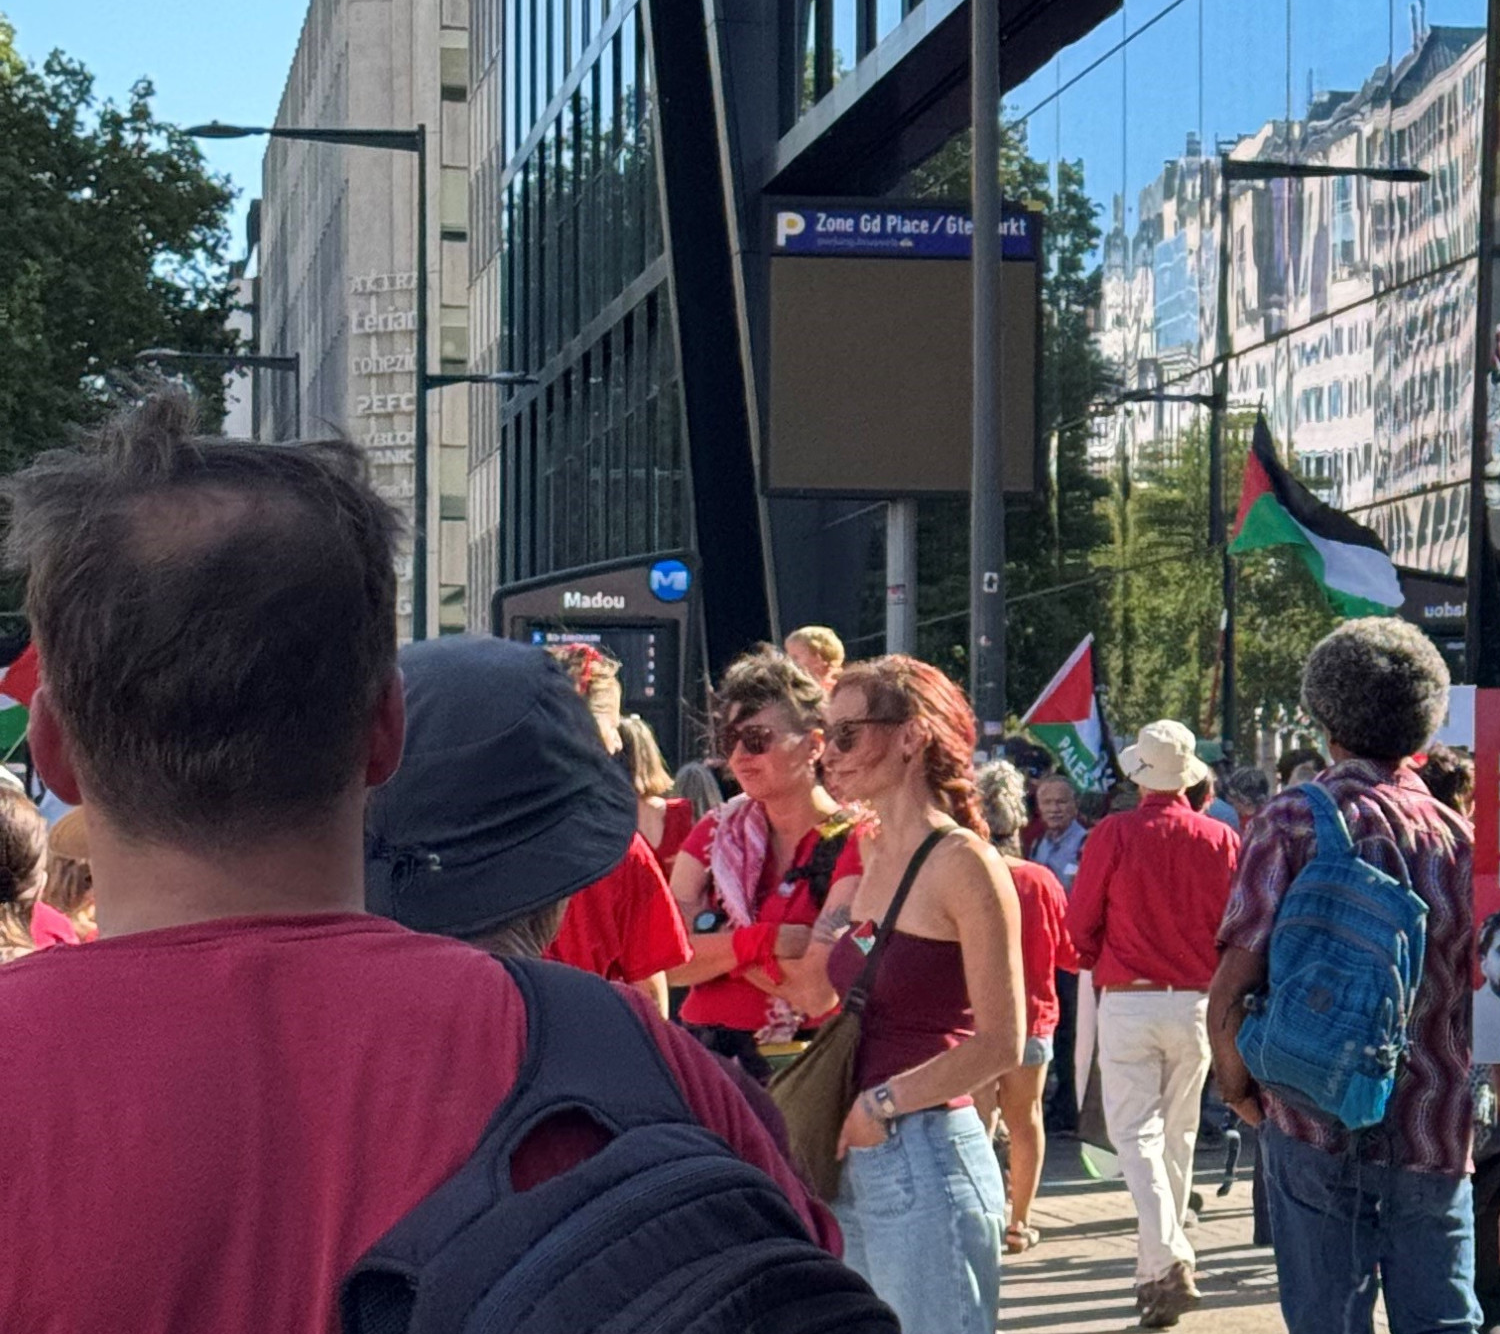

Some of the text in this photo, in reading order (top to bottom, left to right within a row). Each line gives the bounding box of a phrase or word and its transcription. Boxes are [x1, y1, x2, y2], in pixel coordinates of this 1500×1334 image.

[816, 213, 854, 233] Zone
[860, 214, 882, 234] Gd
[887, 215, 929, 235] Place
[998, 217, 1027, 236] arkt
[563, 591, 625, 610] Madou
